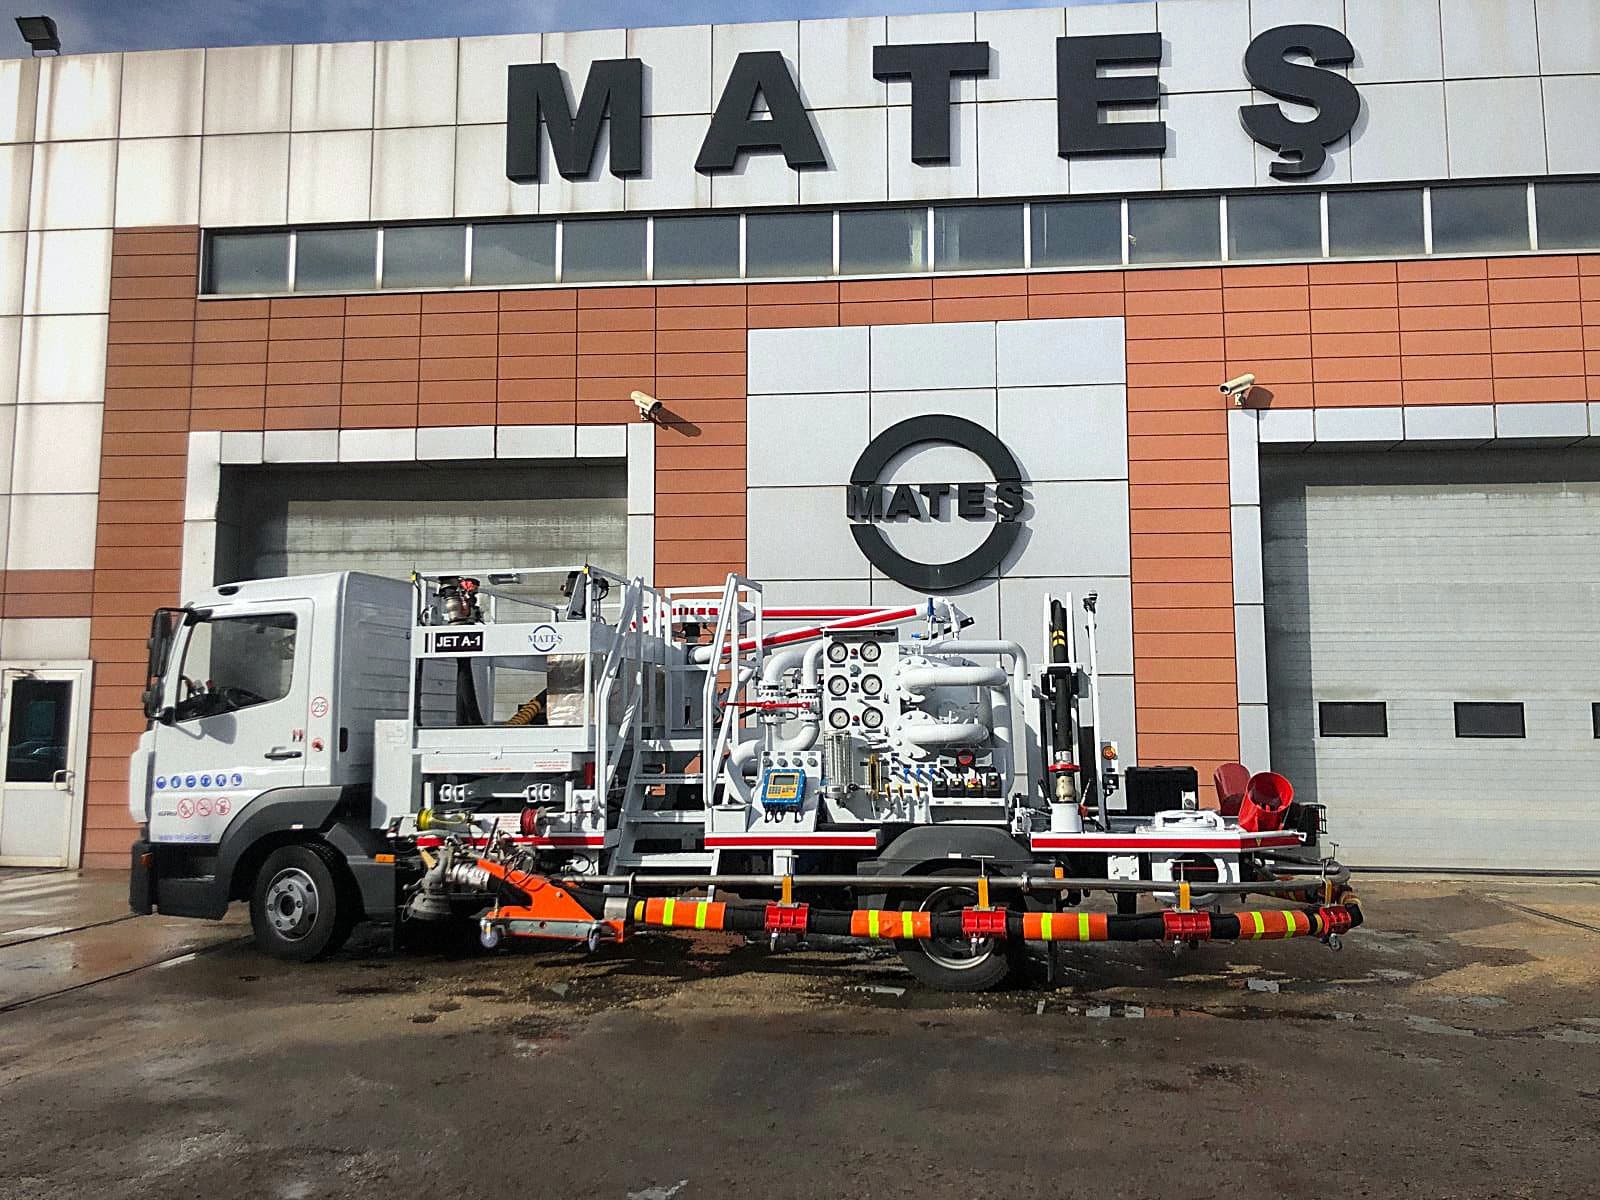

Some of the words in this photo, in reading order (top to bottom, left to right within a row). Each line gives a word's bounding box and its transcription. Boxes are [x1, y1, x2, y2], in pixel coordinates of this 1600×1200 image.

[506, 24, 1361, 184] MATEŞ
[436, 636, 460, 647] JET
[461, 635, 481, 647] A-1
[313, 701, 327, 713] 25
